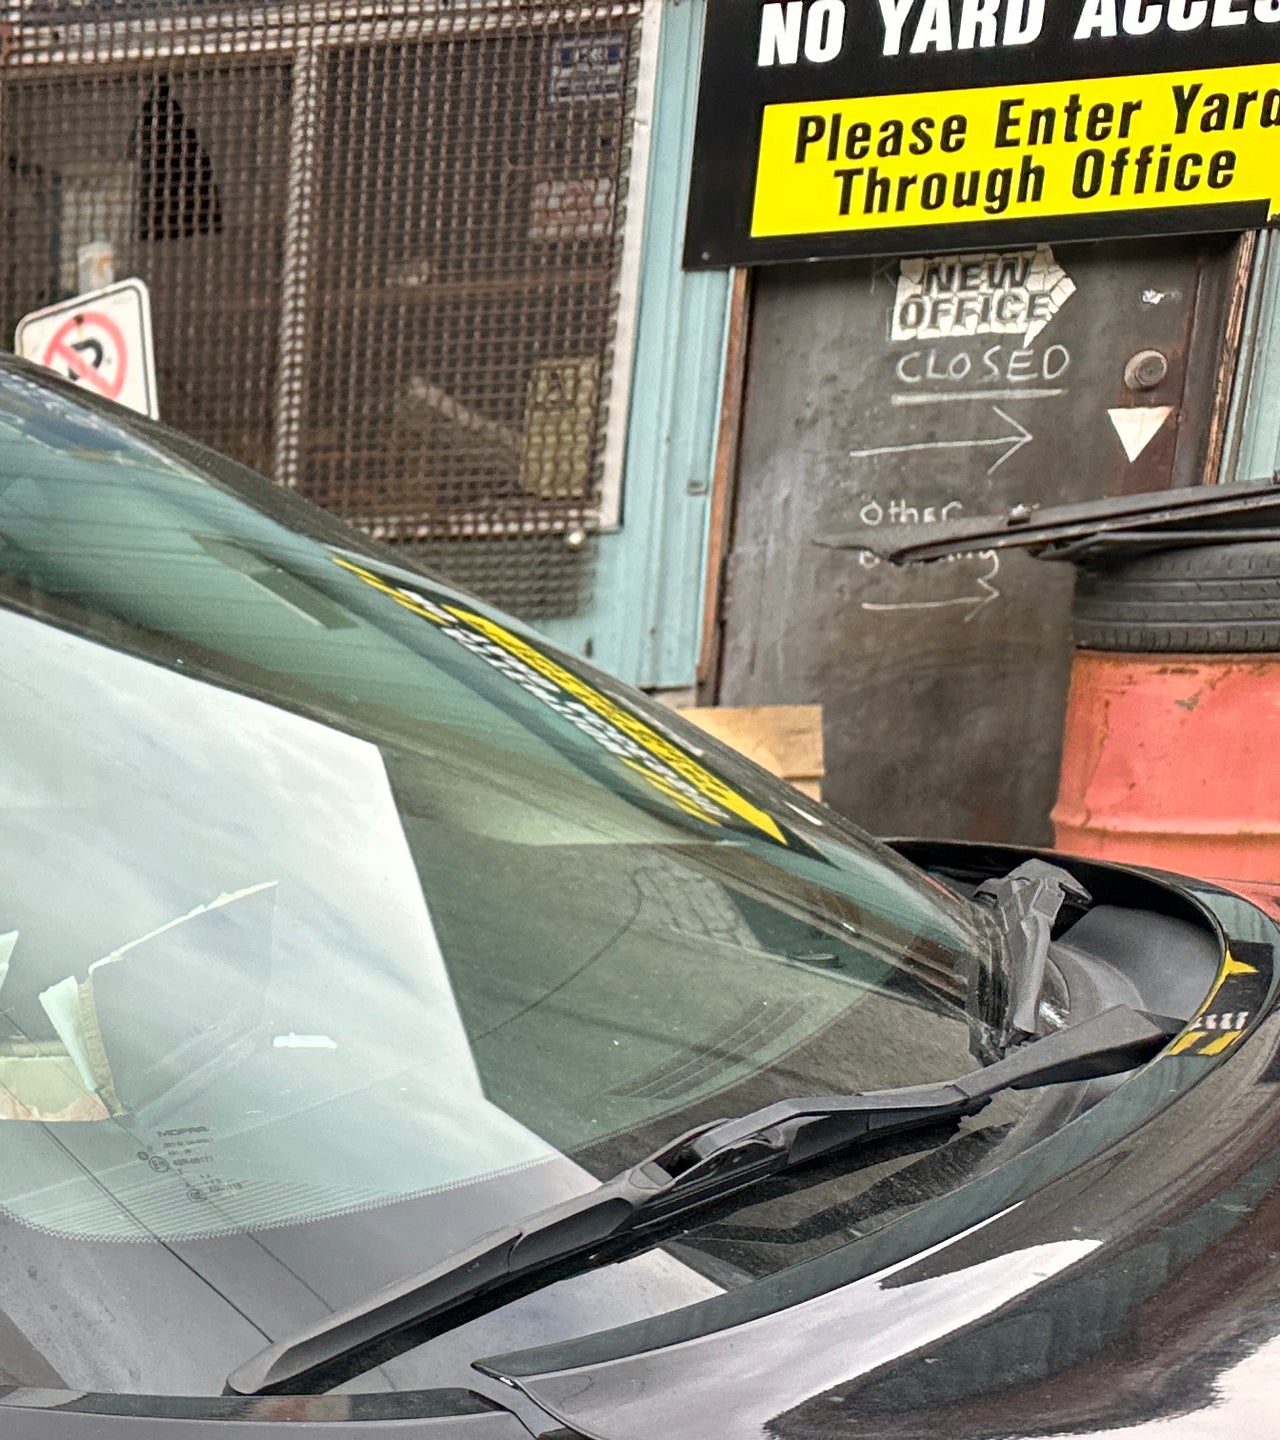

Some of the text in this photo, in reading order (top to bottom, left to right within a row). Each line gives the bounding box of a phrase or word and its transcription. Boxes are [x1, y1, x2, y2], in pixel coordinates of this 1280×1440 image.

[757, 1, 846, 67] NO
[878, 0, 1045, 56] YARD
[795, 83, 1280, 163] Please Enter Yard
[834, 143, 1237, 216] Through Office
[925, 261, 1032, 293] NEW
[899, 291, 1053, 330] OFFICE
[896, 345, 1071, 383] CLOSED
